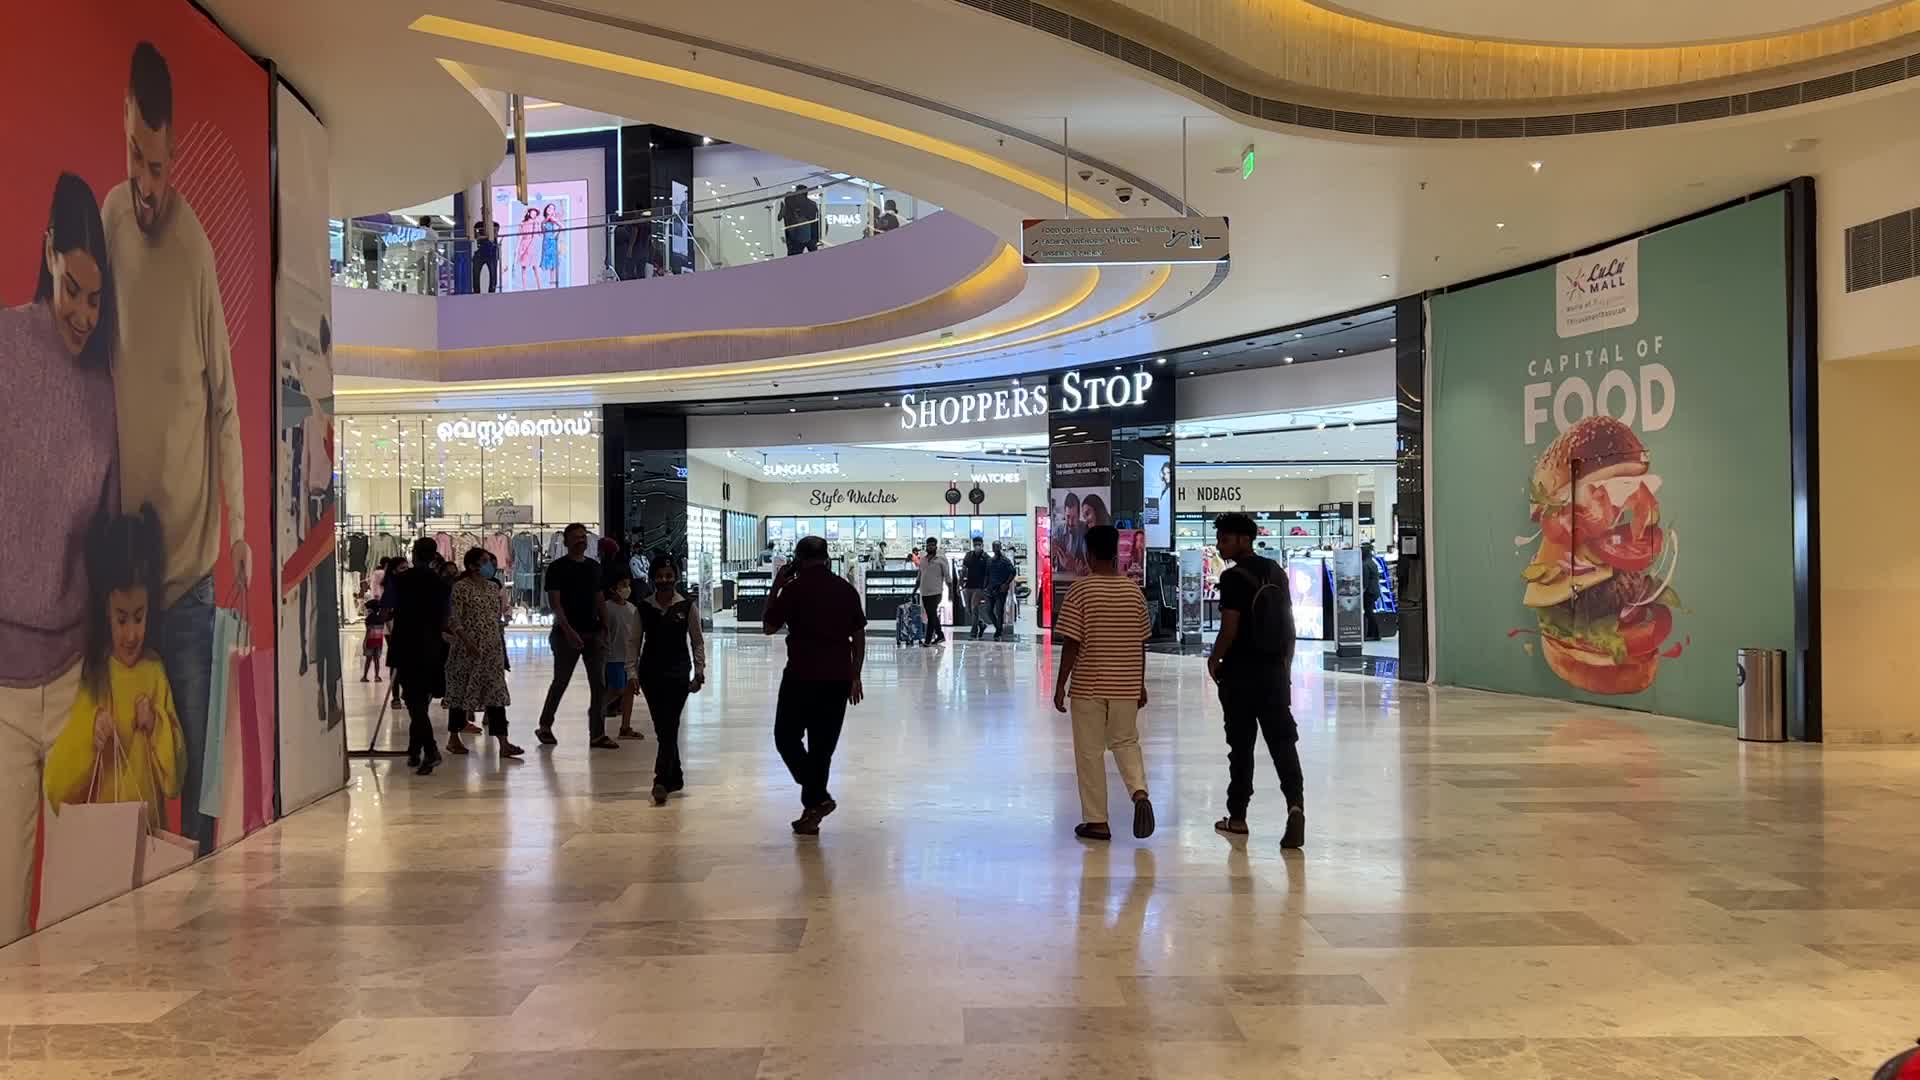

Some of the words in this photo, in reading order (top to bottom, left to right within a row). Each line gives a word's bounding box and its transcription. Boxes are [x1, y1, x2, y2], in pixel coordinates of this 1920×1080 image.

[825, 213, 862, 225] ENIMS
[1590, 277, 1625, 294] MALL
[1527, 344, 1624, 377] CAPITAL
[1636, 336, 1664, 357] OF
[901, 384, 1049, 430] SHOPPERS
[1062, 369, 1153, 413] STOP
[1524, 363, 1676, 445] FOOD
[763, 462, 840, 477] SUNGLASSES
[970, 472, 1020, 483] WATCHES
[809, 488, 845, 512] Style
[846, 488, 899, 505] Watches
